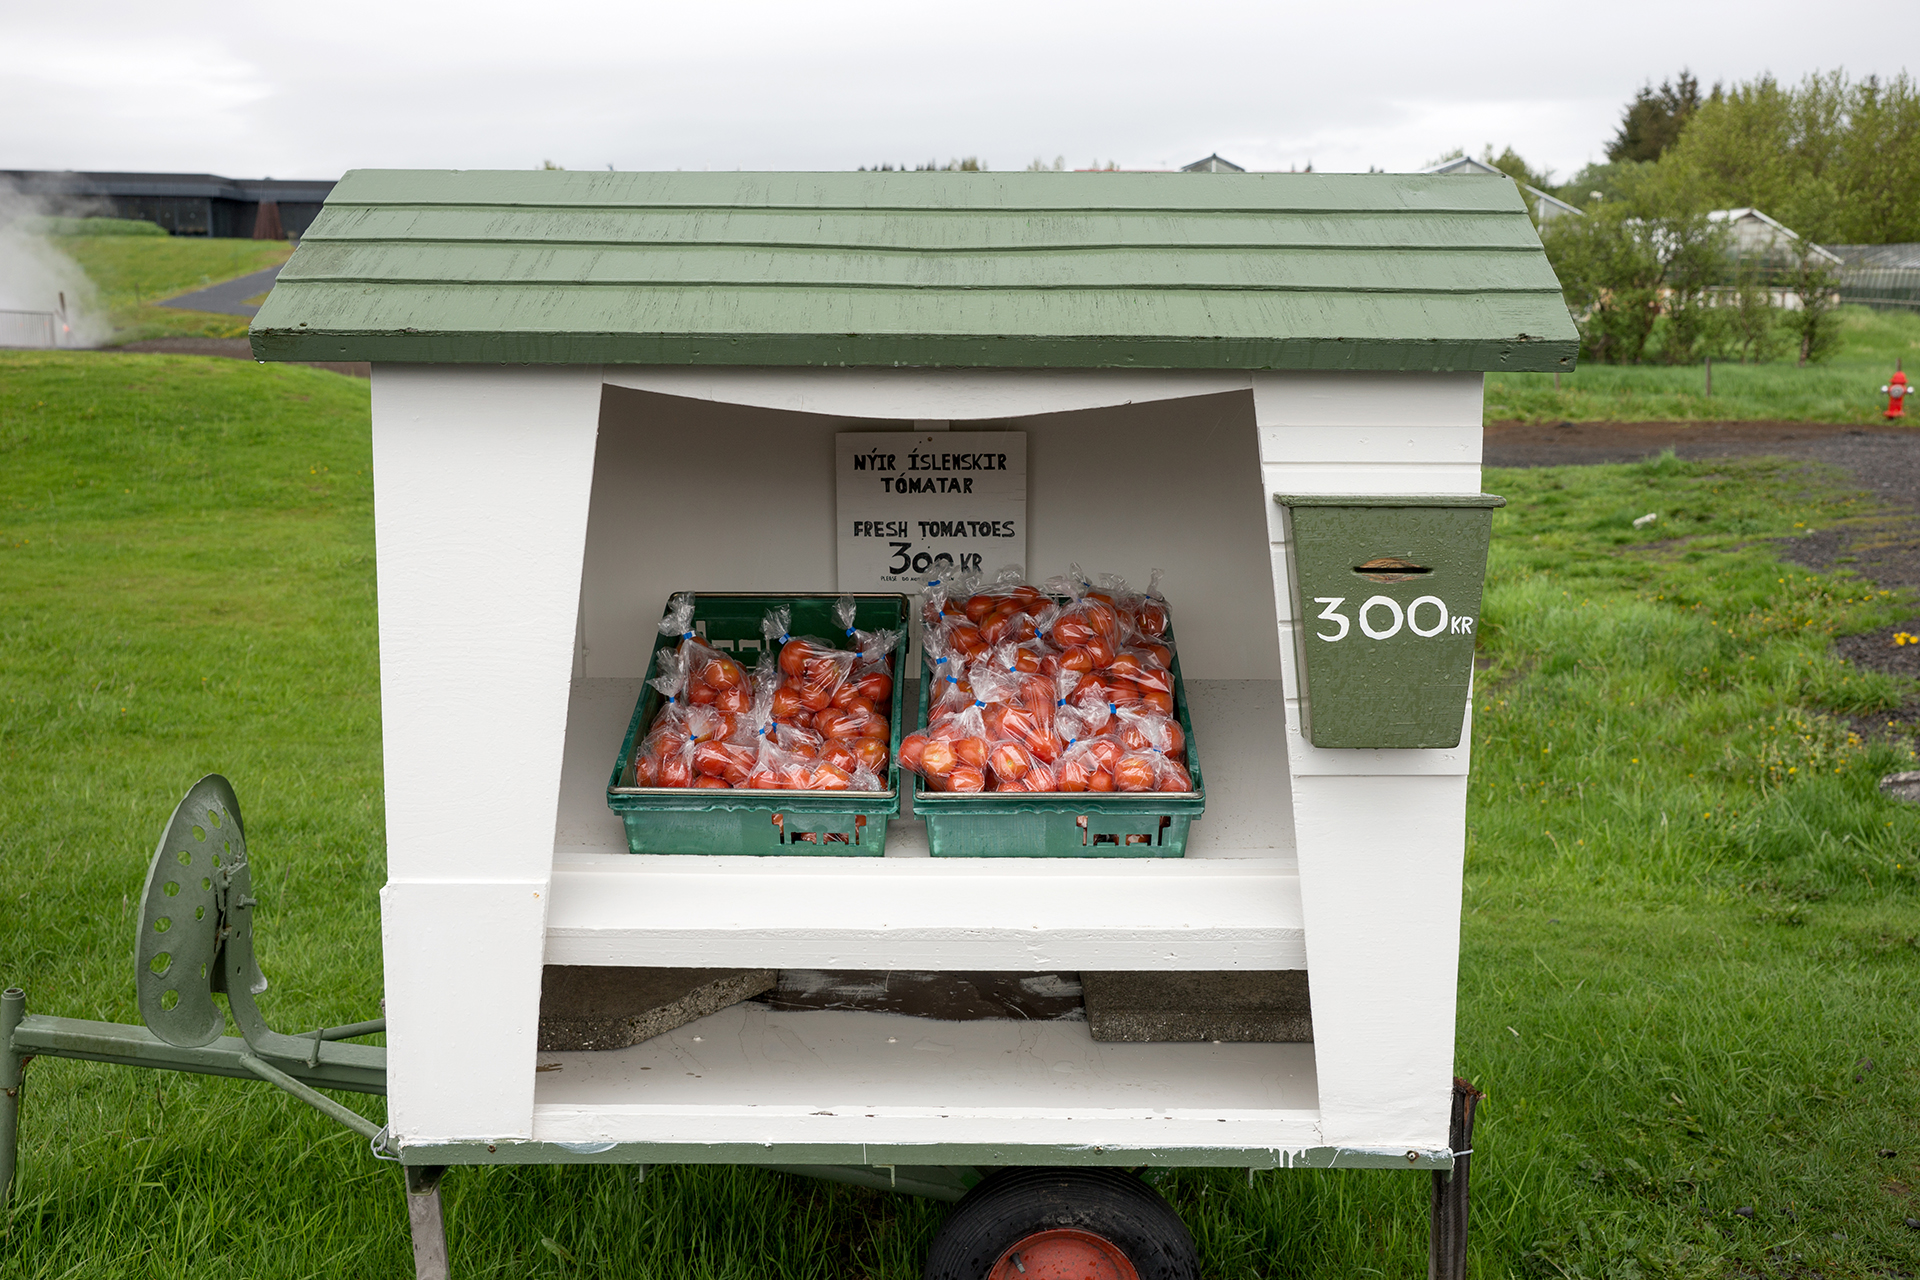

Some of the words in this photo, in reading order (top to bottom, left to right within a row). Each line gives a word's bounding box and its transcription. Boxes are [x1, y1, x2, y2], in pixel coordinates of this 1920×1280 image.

[854, 447, 896, 471] NÝIR
[908, 447, 1007, 471] ÍSLENSKIR
[880, 472, 974, 494] TÓMATAR
[853, 521, 908, 538] FRESH
[918, 521, 1016, 538] TOMATOES
[888, 541, 954, 575] 300
[960, 553, 983, 574] KR
[1314, 595, 1449, 642] 300
[1450, 615, 1474, 635] KR
